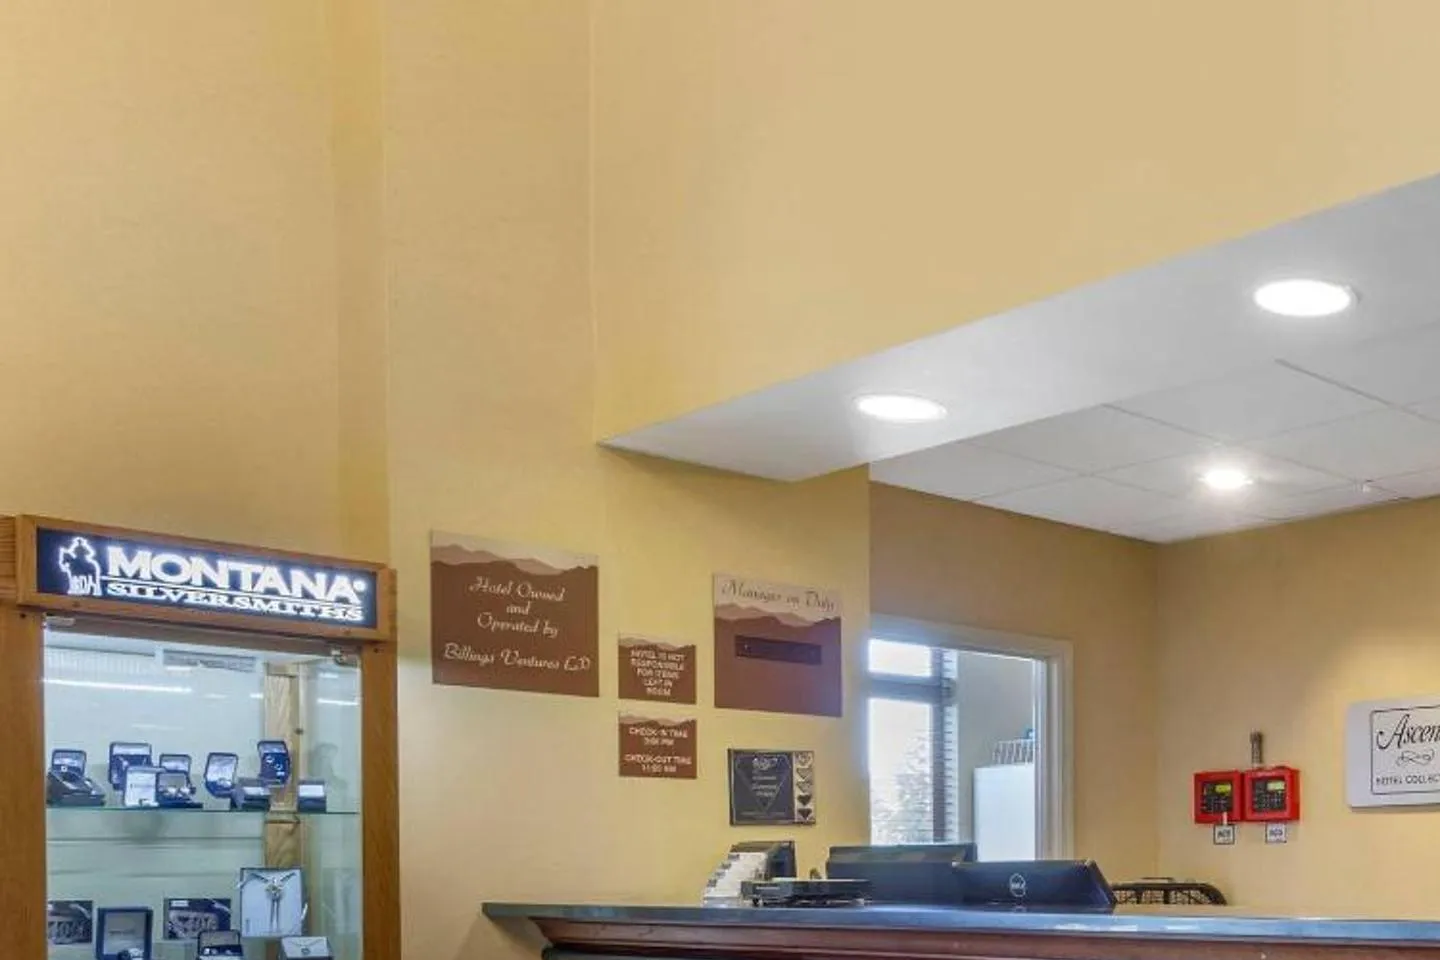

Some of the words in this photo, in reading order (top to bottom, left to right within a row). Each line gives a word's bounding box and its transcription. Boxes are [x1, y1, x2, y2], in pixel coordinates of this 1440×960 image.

[106, 547, 362, 604] MONTANA
[469, 576, 513, 596] Hotel
[106, 582, 363, 621] SILVERSMITHS
[506, 601, 531, 615] and
[477, 611, 540, 632] Operated
[543, 621, 558, 638] by
[444, 642, 495, 666] Billings
[500, 648, 560, 670] Ventures
[1376, 775, 1403, 786] HOTEL
